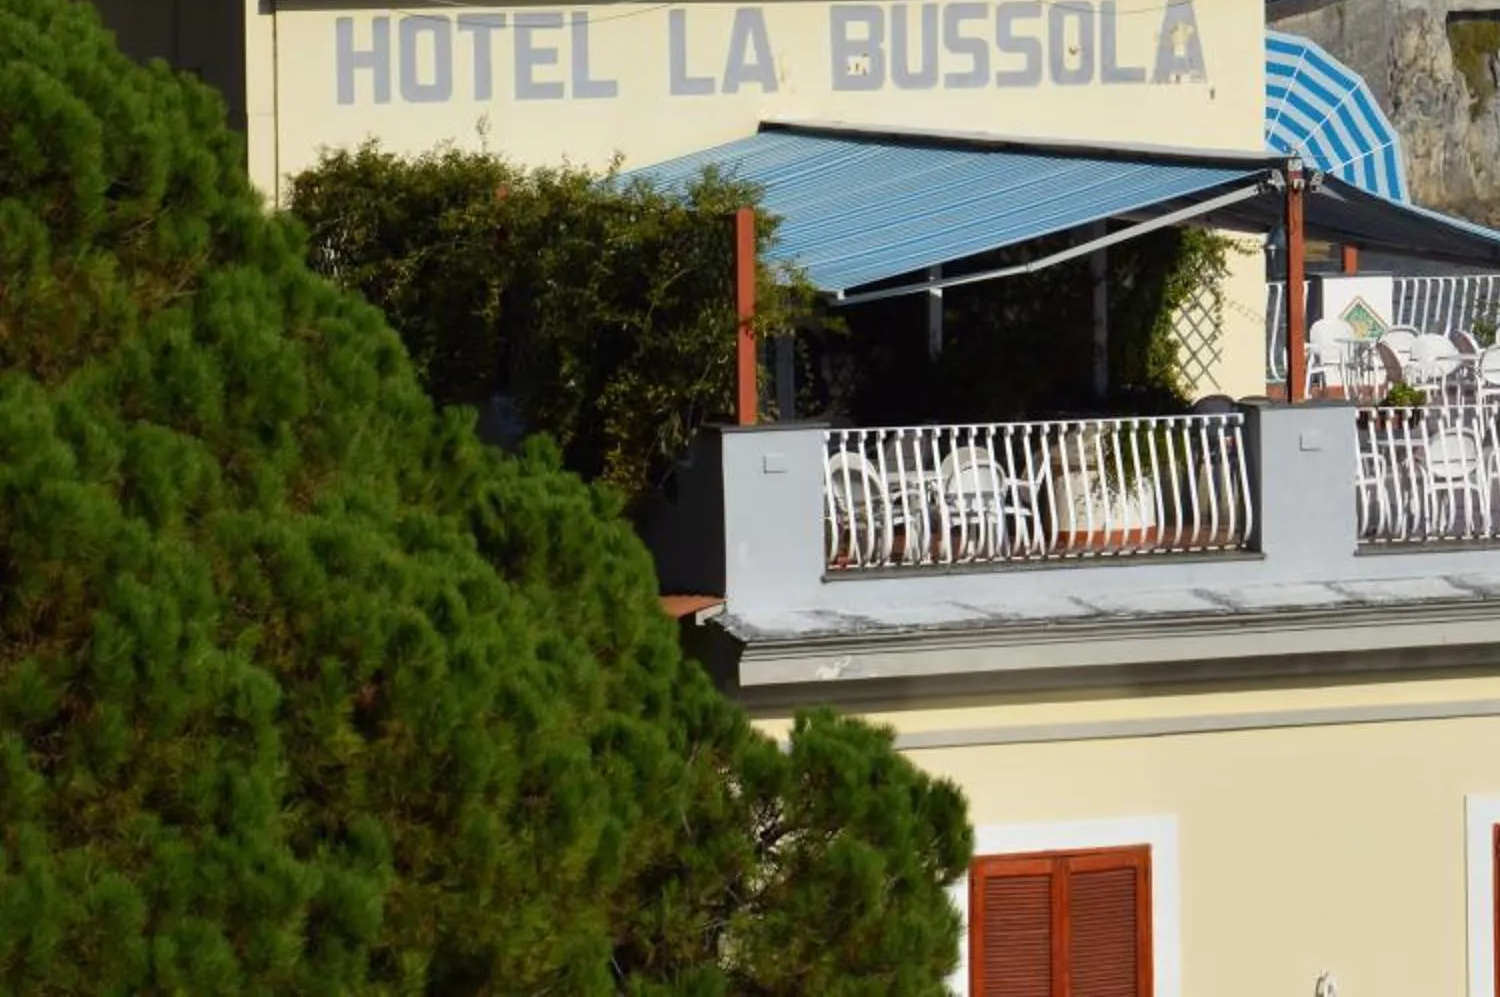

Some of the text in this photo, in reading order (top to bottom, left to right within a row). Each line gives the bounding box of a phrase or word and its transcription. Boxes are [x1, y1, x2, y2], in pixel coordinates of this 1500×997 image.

[335, 0, 1208, 104] HOTEL LA BUSSOLA
